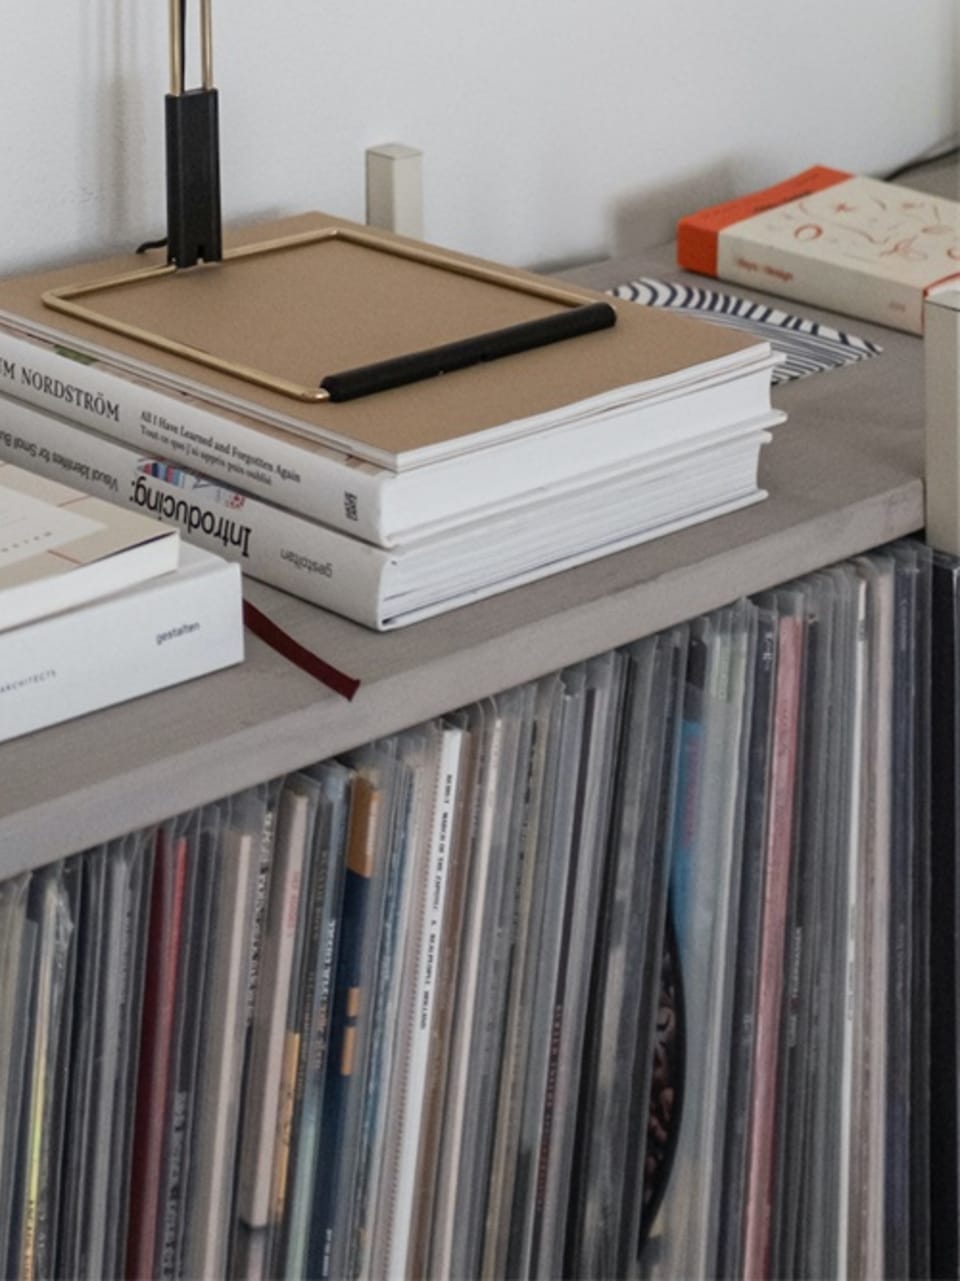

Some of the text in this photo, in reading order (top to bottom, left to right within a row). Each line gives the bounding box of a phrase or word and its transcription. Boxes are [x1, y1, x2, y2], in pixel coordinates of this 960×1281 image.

[21, 367, 120, 421] NORDSTRÖM
[13, 437, 38, 457] Small
[39, 447, 51, 463] for
[159, 416, 178, 435] Have
[180, 424, 213, 448] Learned
[214, 441, 230, 455] and
[231, 445, 273, 472] Forgotten
[276, 463, 301, 483] Again
[52, 452, 90, 480] Identities
[91, 468, 119, 492] Visual
[129, 475, 253, 558] Introducing:
[156, 621, 201, 646] gestalten
[0, 669, 57, 694] ARCHITECTS
